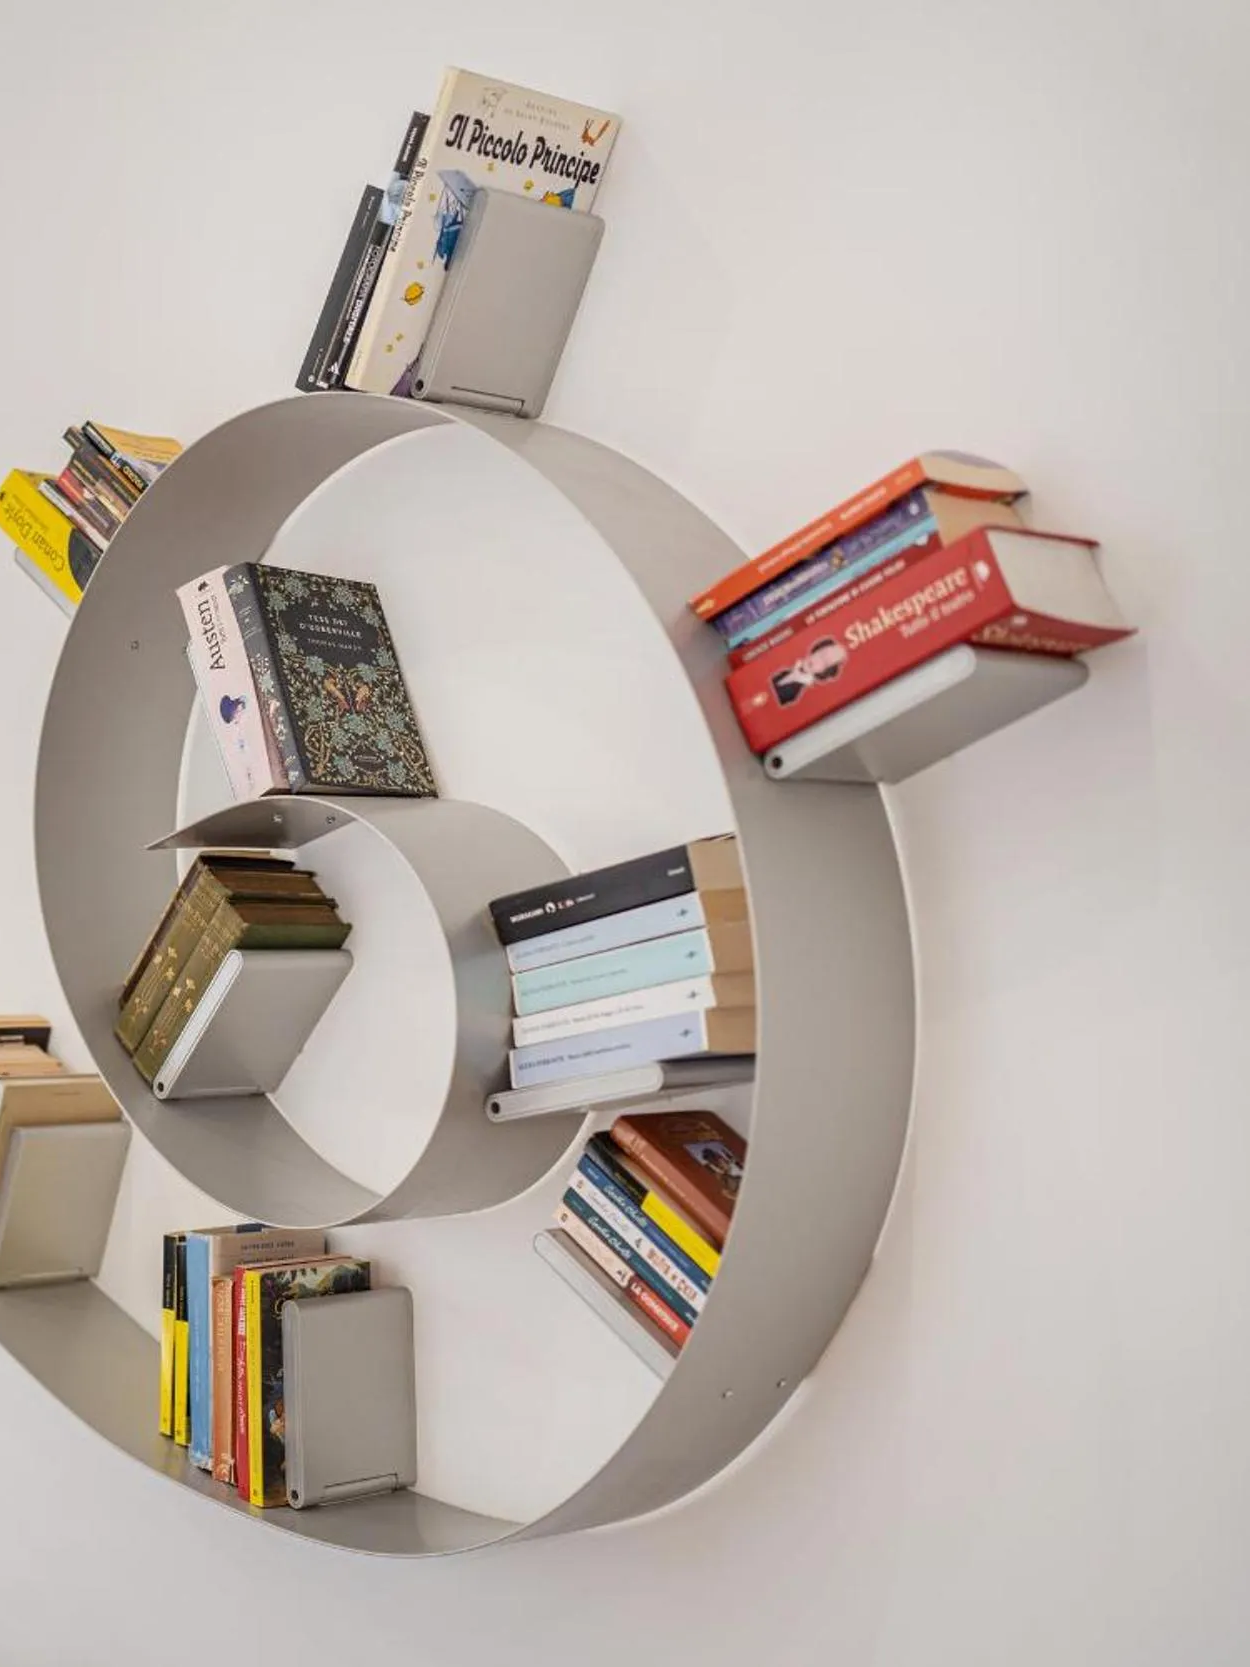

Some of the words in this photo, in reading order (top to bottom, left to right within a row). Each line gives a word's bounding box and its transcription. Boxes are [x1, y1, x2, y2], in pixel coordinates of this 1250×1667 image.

[469, 120, 528, 168] Piccolo
[529, 135, 602, 193] Principe
[33, 525, 65, 572] Conan
[196, 599, 226, 671] Austen
[843, 564, 968, 649] Shakespeare
